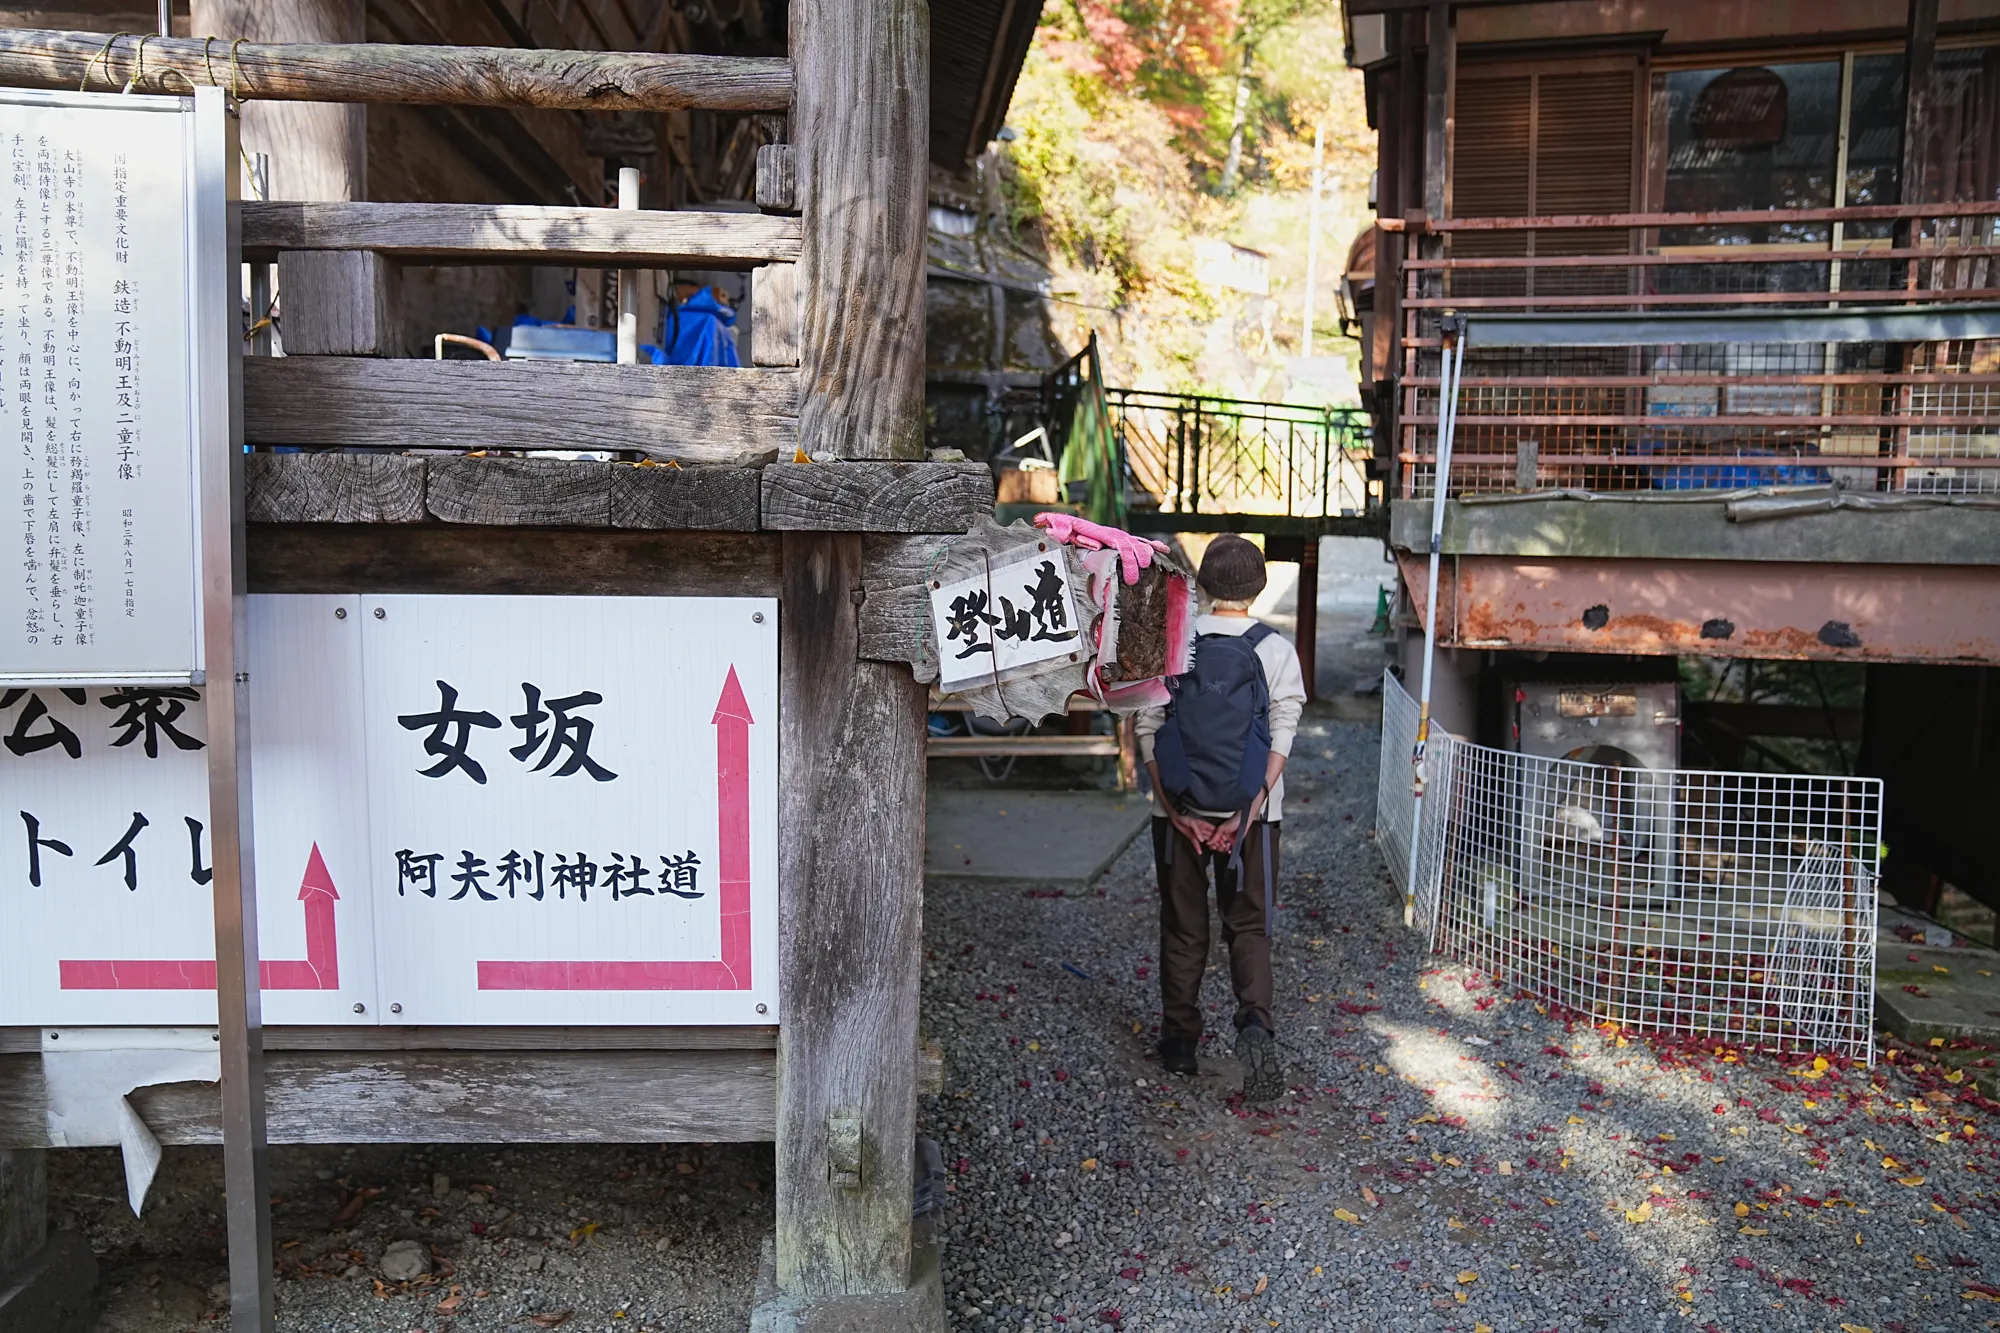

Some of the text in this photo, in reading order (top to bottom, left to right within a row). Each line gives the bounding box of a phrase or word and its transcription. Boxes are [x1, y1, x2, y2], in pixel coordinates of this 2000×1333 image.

[114, 152, 129, 264] 国指定重要文化財
[945, 560, 1079, 660] 登山道
[397, 680, 619, 785] 女坂
[394, 849, 706, 902] 阿夫利神社道
